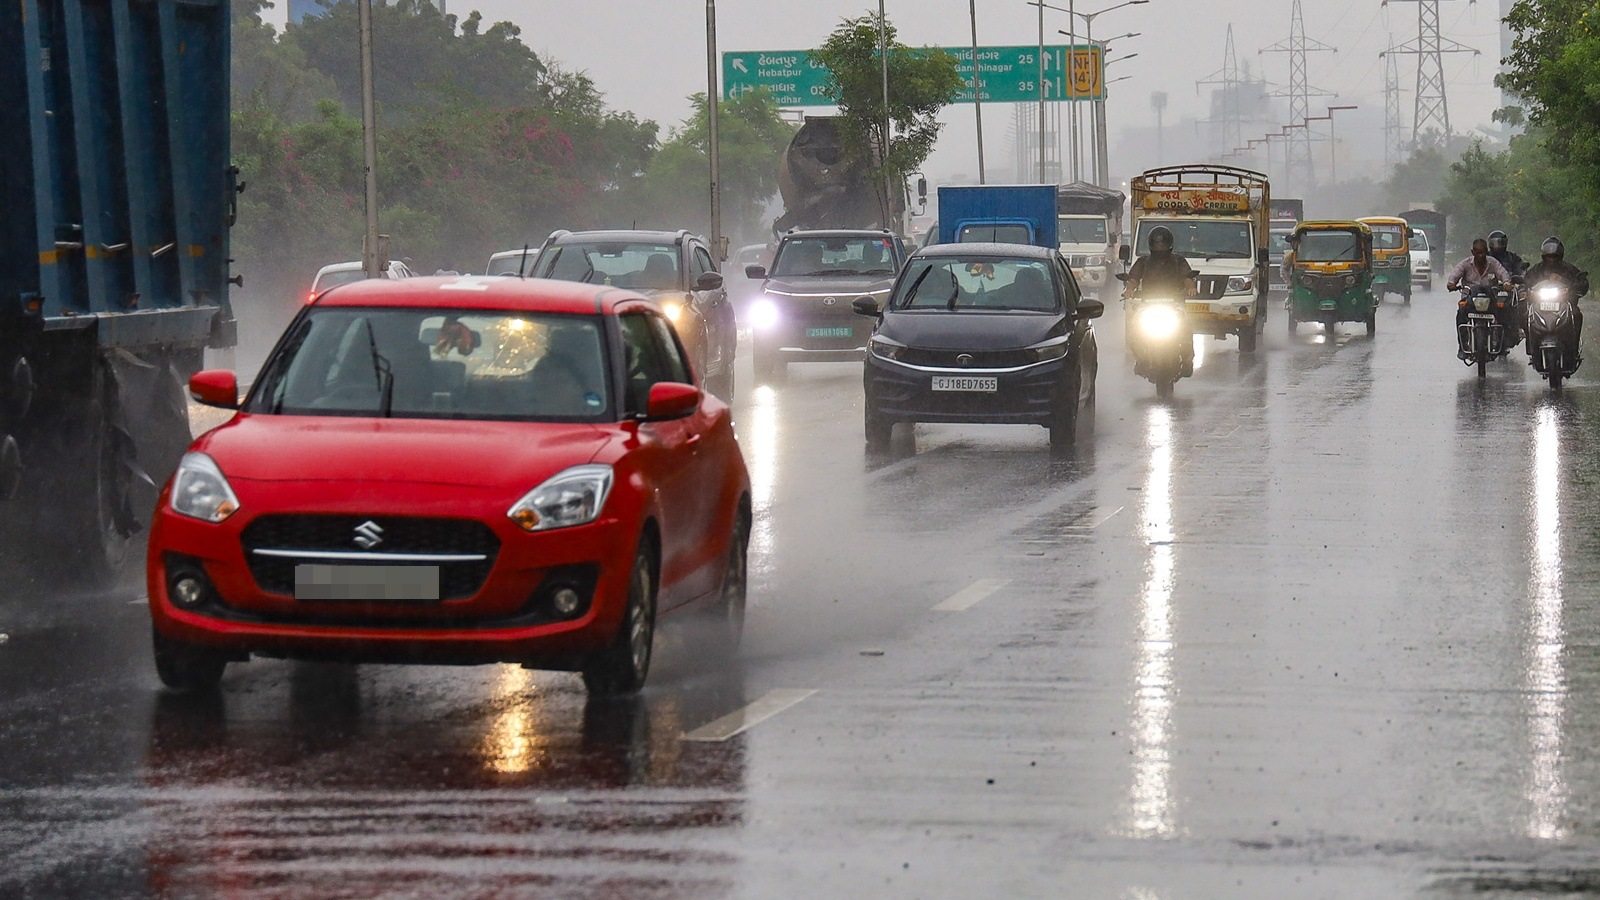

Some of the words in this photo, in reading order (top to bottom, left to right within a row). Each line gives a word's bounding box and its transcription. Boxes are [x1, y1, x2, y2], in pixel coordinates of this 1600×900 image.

[954, 49, 999, 60] ગાંધનગર
[1018, 54, 1033, 65] 25
[954, 63, 1013, 73] Ganhinagar
[758, 69, 802, 78] Hebatpur
[759, 83, 796, 92] તાધાર
[1018, 81, 1034, 91] 35
[938, 379, 996, 389] GJ18ED7655
